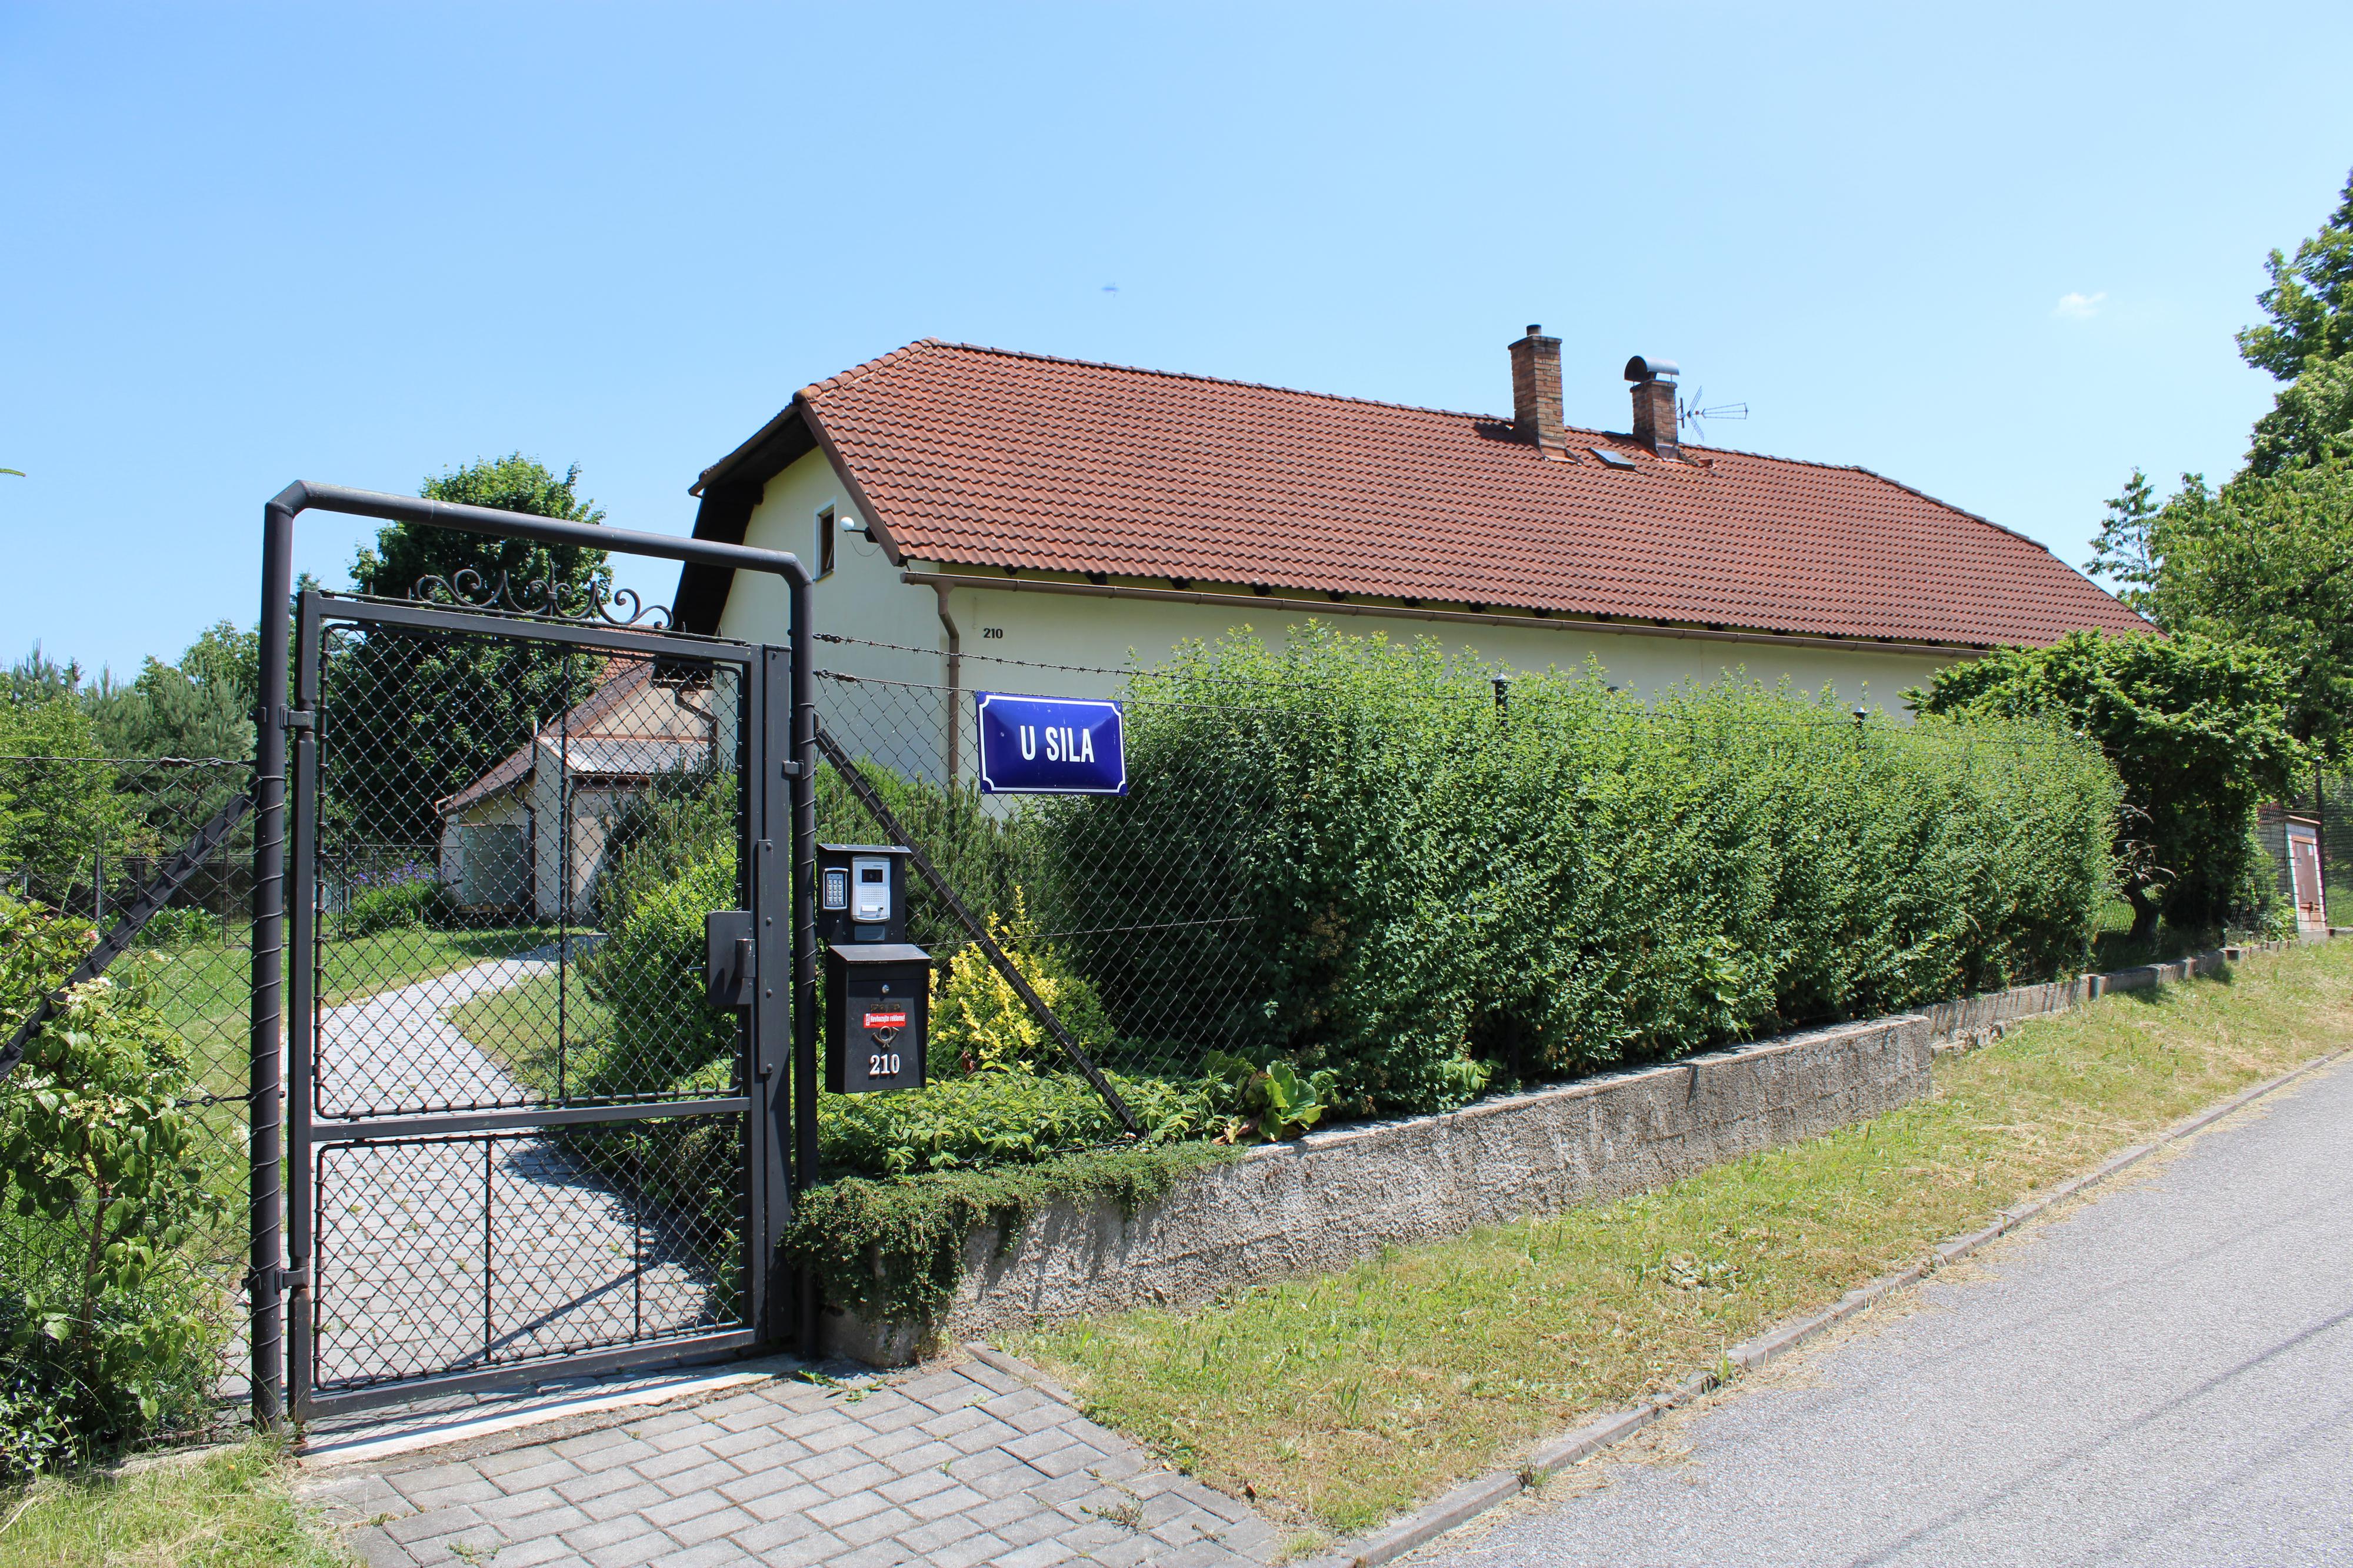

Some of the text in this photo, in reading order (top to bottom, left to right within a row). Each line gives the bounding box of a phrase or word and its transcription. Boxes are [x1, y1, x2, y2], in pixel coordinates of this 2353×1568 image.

[983, 628, 1004, 639] 210
[1020, 725, 1095, 763] U SILA
[869, 1054, 900, 1076] 210
